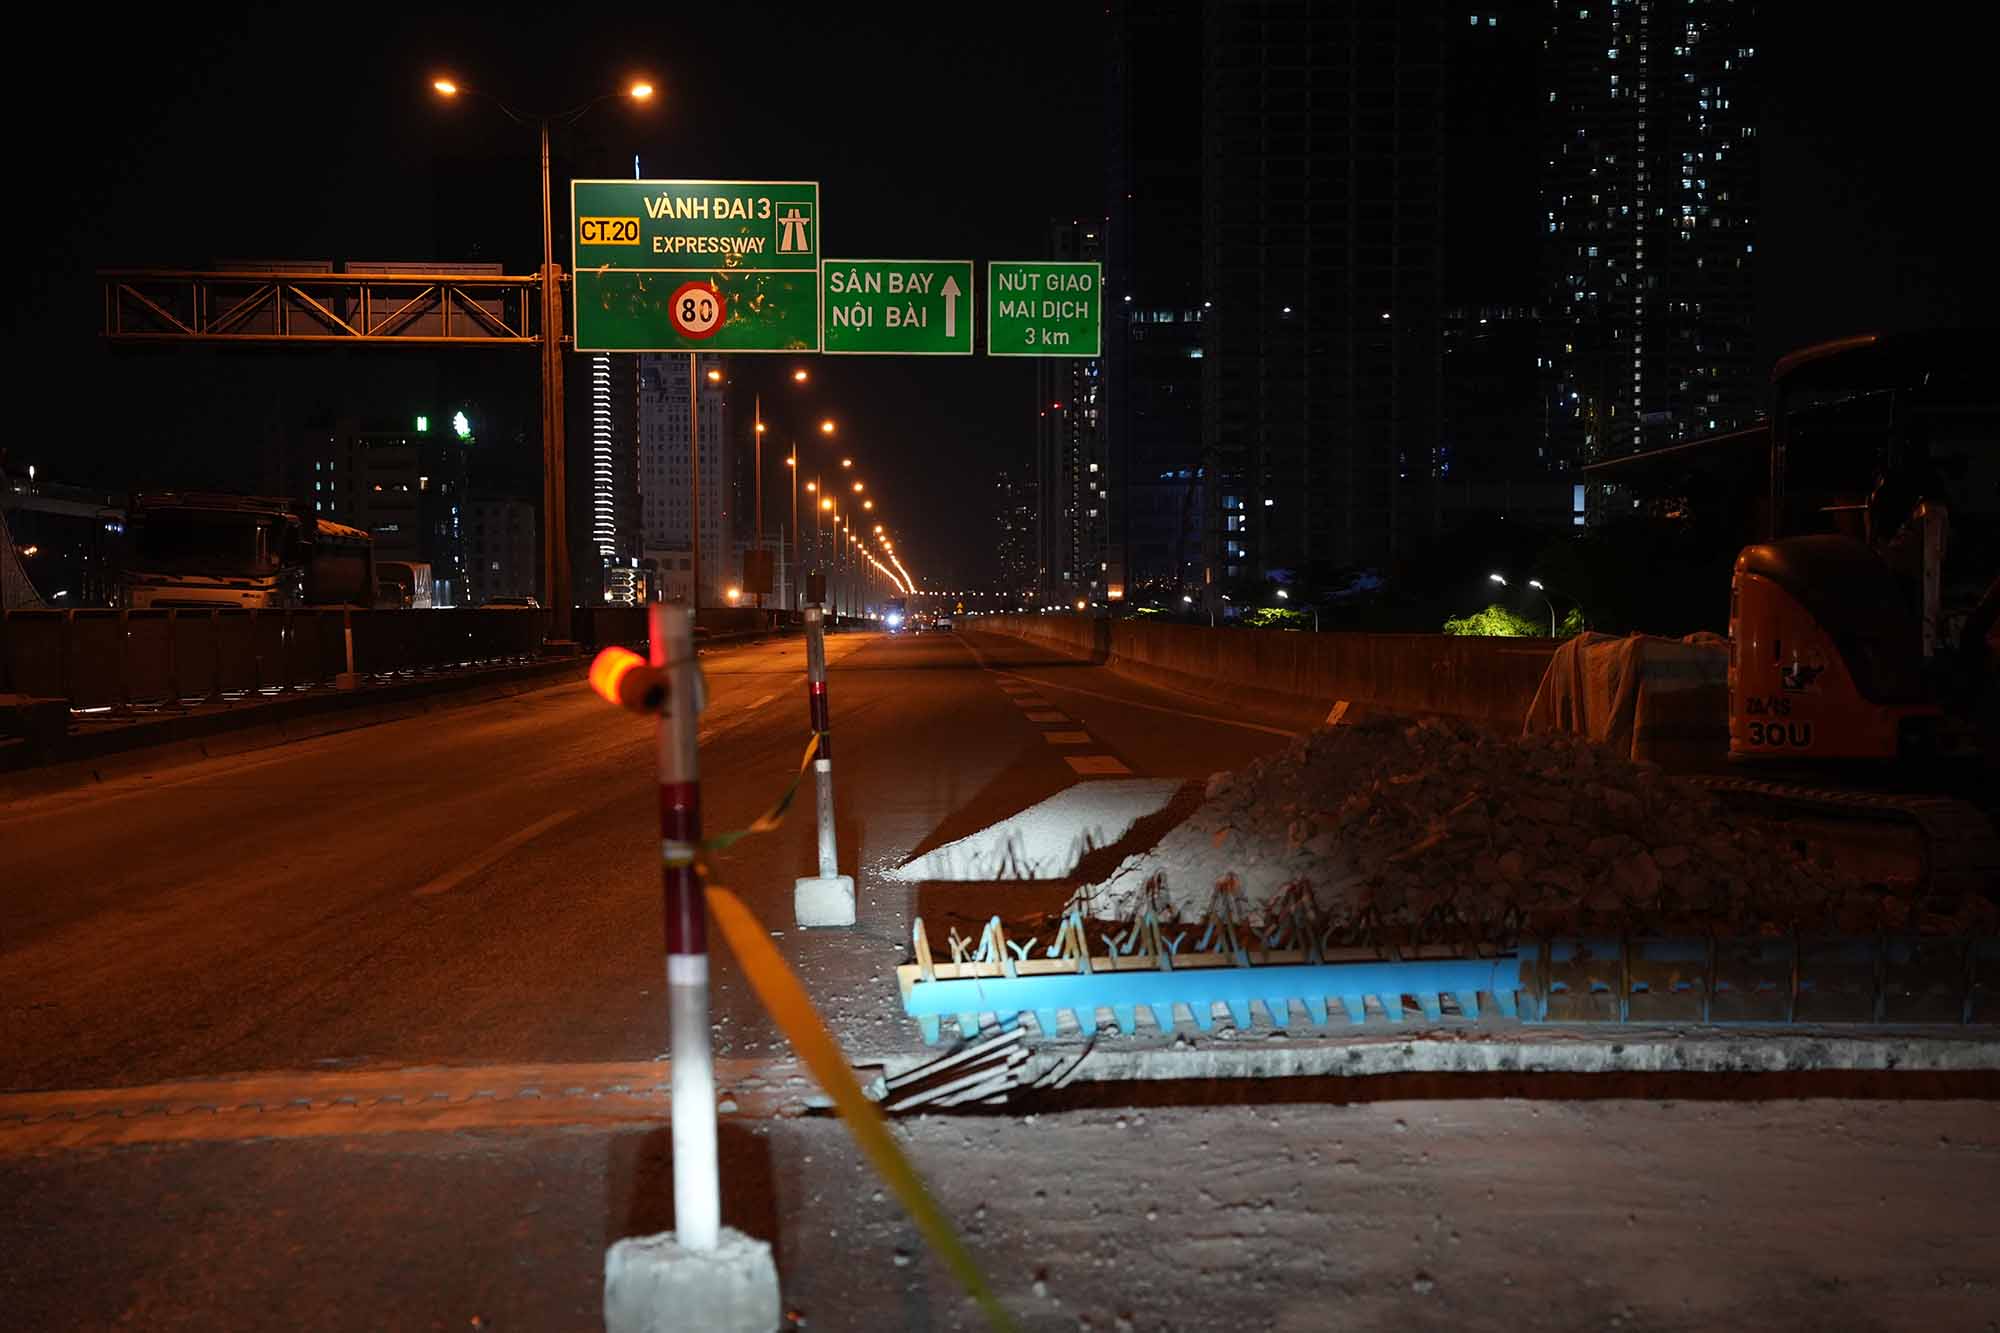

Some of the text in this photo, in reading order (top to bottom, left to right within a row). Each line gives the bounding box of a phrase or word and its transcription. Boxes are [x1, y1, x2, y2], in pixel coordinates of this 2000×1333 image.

[644, 192, 771, 220] VÀNH ĐAI 3
[581, 220, 639, 242] CT.20
[653, 236, 766, 254] EXPRESSWAY
[830, 268, 934, 294] SÂN BAY
[998, 269, 1092, 292] NÚT GIAO
[682, 298, 713, 323] 80
[832, 302, 927, 332] NỘI BÀI
[999, 301, 1089, 322] MAI DỊCH
[1025, 328, 1070, 345] 3 km
[1747, 721, 1813, 748] 30U
